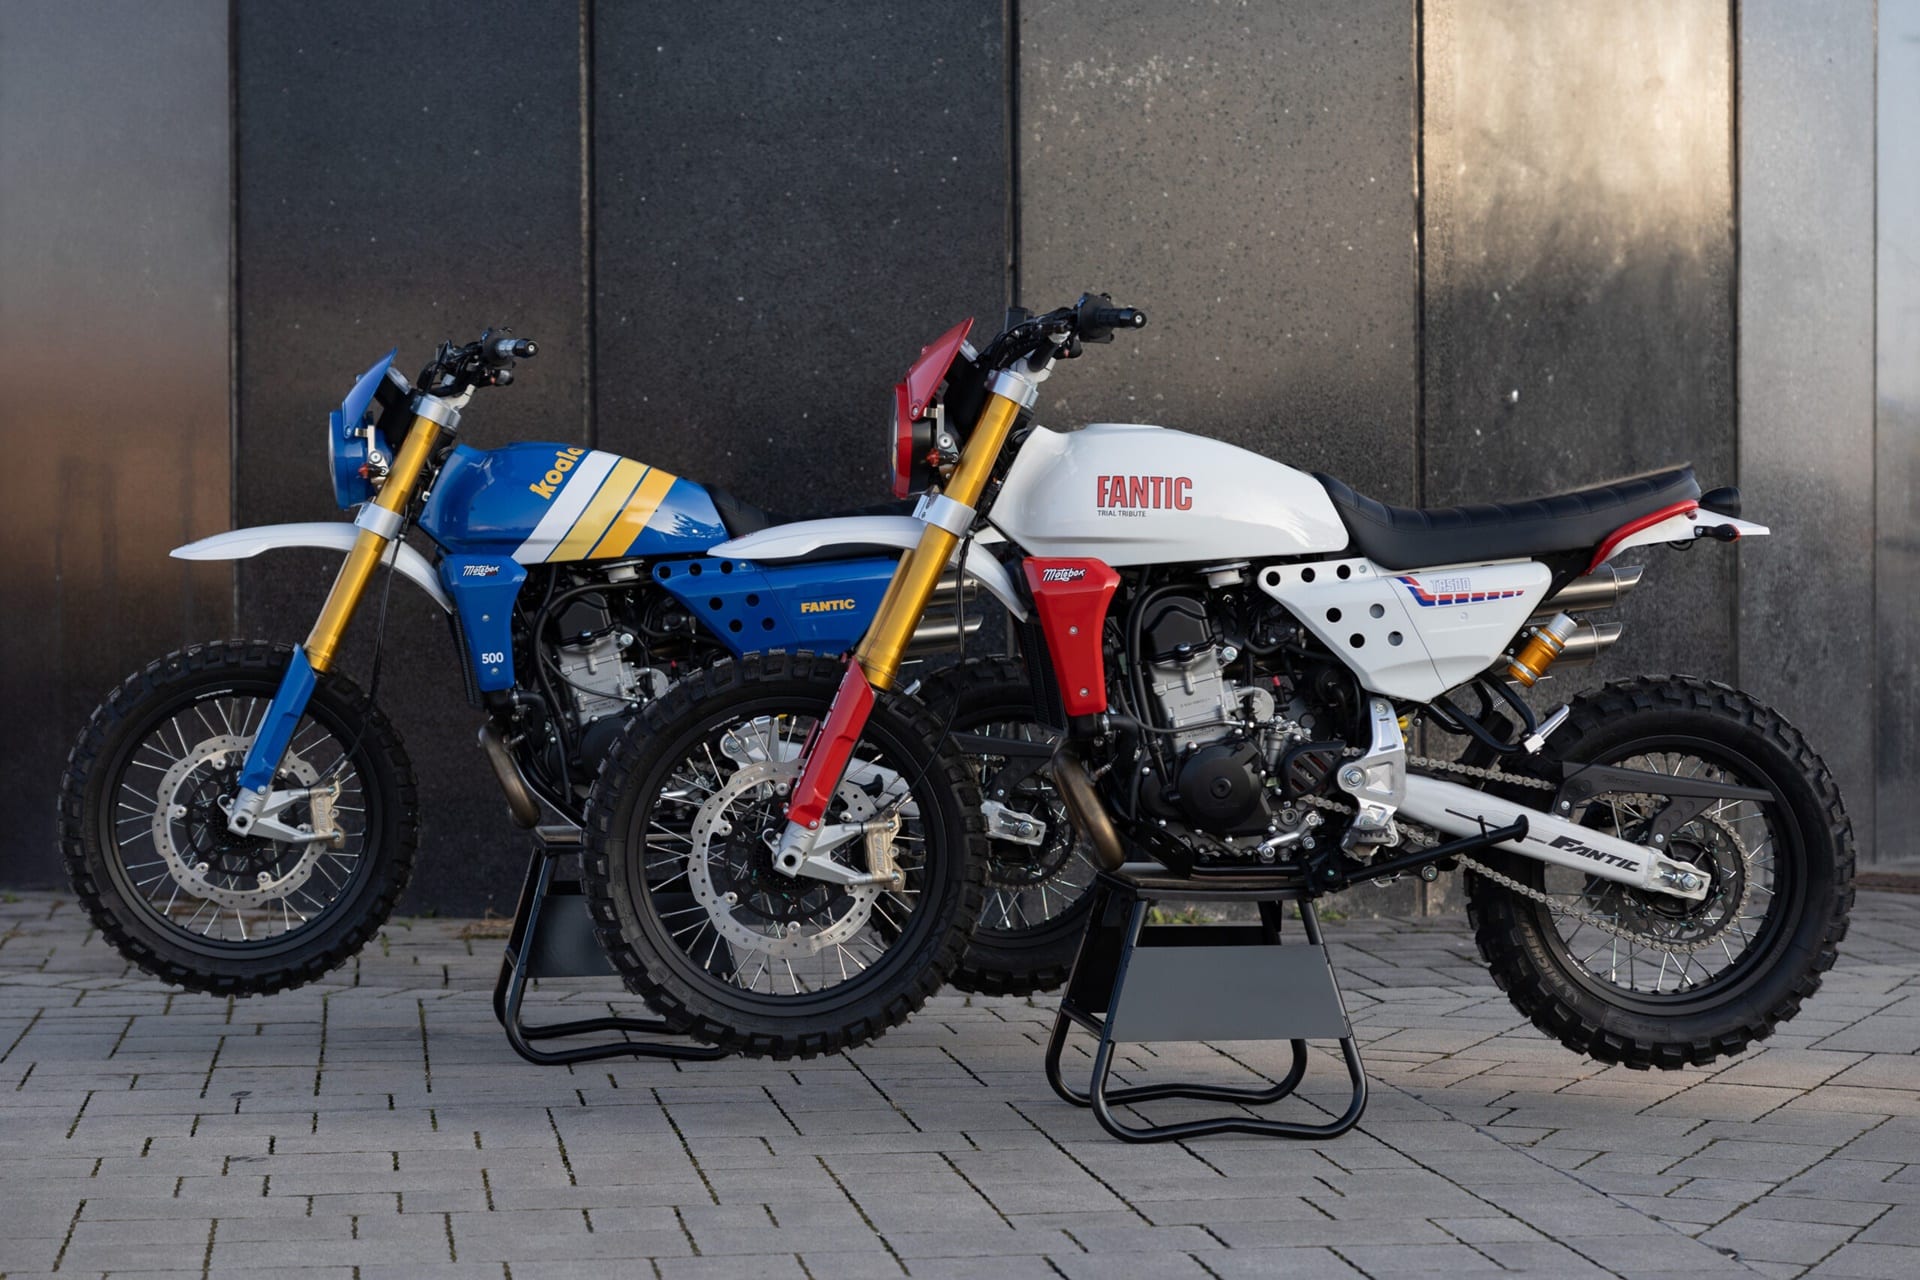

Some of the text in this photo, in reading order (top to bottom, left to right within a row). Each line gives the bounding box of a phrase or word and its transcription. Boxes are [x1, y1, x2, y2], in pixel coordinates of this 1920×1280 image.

[1097, 475, 1193, 511] FANTIC
[1118, 510, 1147, 518] TRIBUTE
[1042, 567, 1086, 582] Motobox
[801, 598, 856, 613] FANTIC
[481, 651, 505, 664] 500
[1548, 834, 1640, 872] FANTIC
